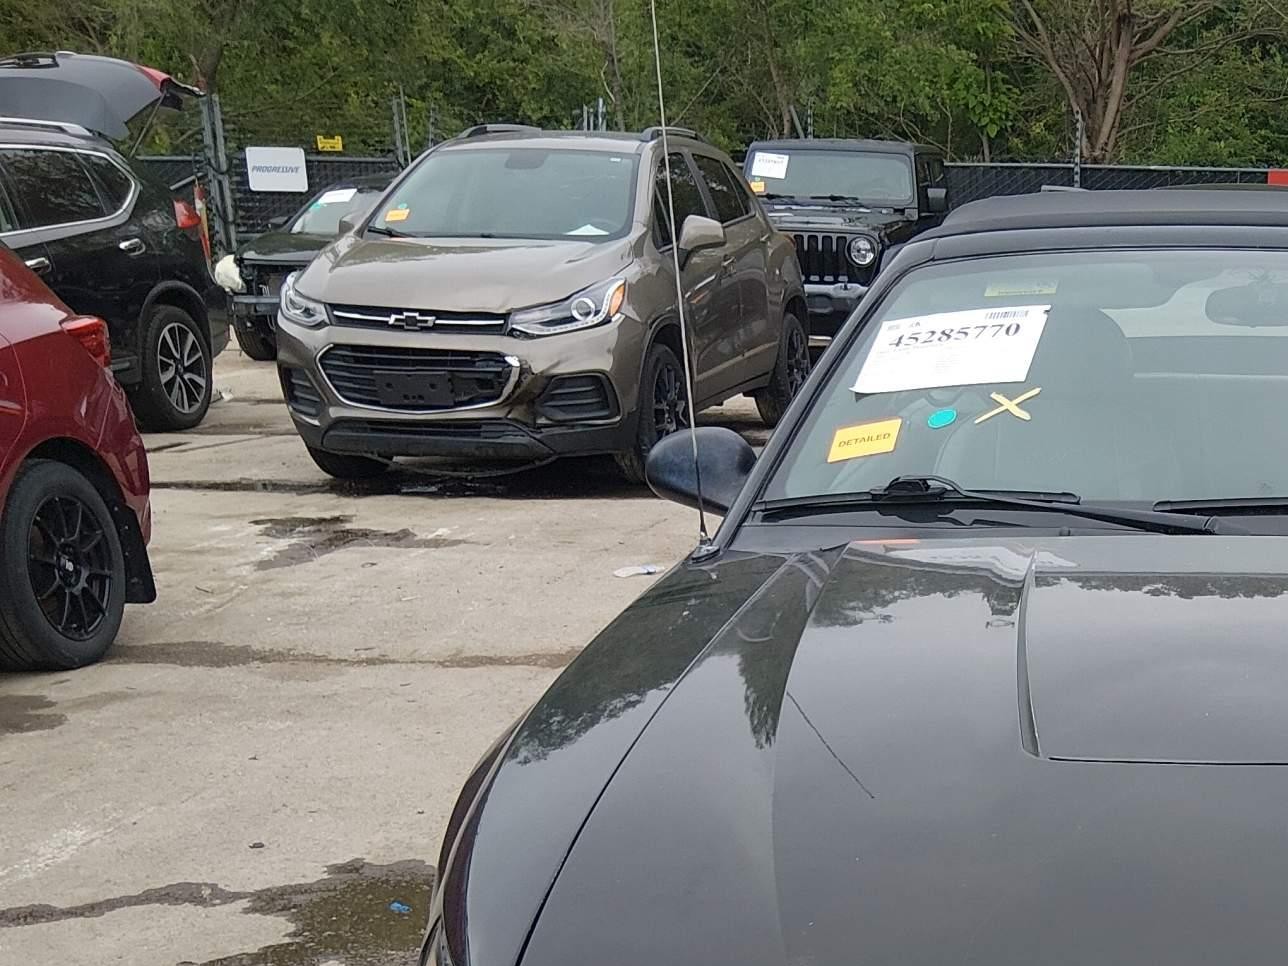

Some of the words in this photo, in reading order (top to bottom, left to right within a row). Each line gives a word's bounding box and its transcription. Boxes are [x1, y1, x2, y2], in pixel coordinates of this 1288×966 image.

[251, 165, 301, 174] PROGRESSIVE
[889, 323, 1020, 347] 45285770
[837, 432, 892, 448] DETAILED
